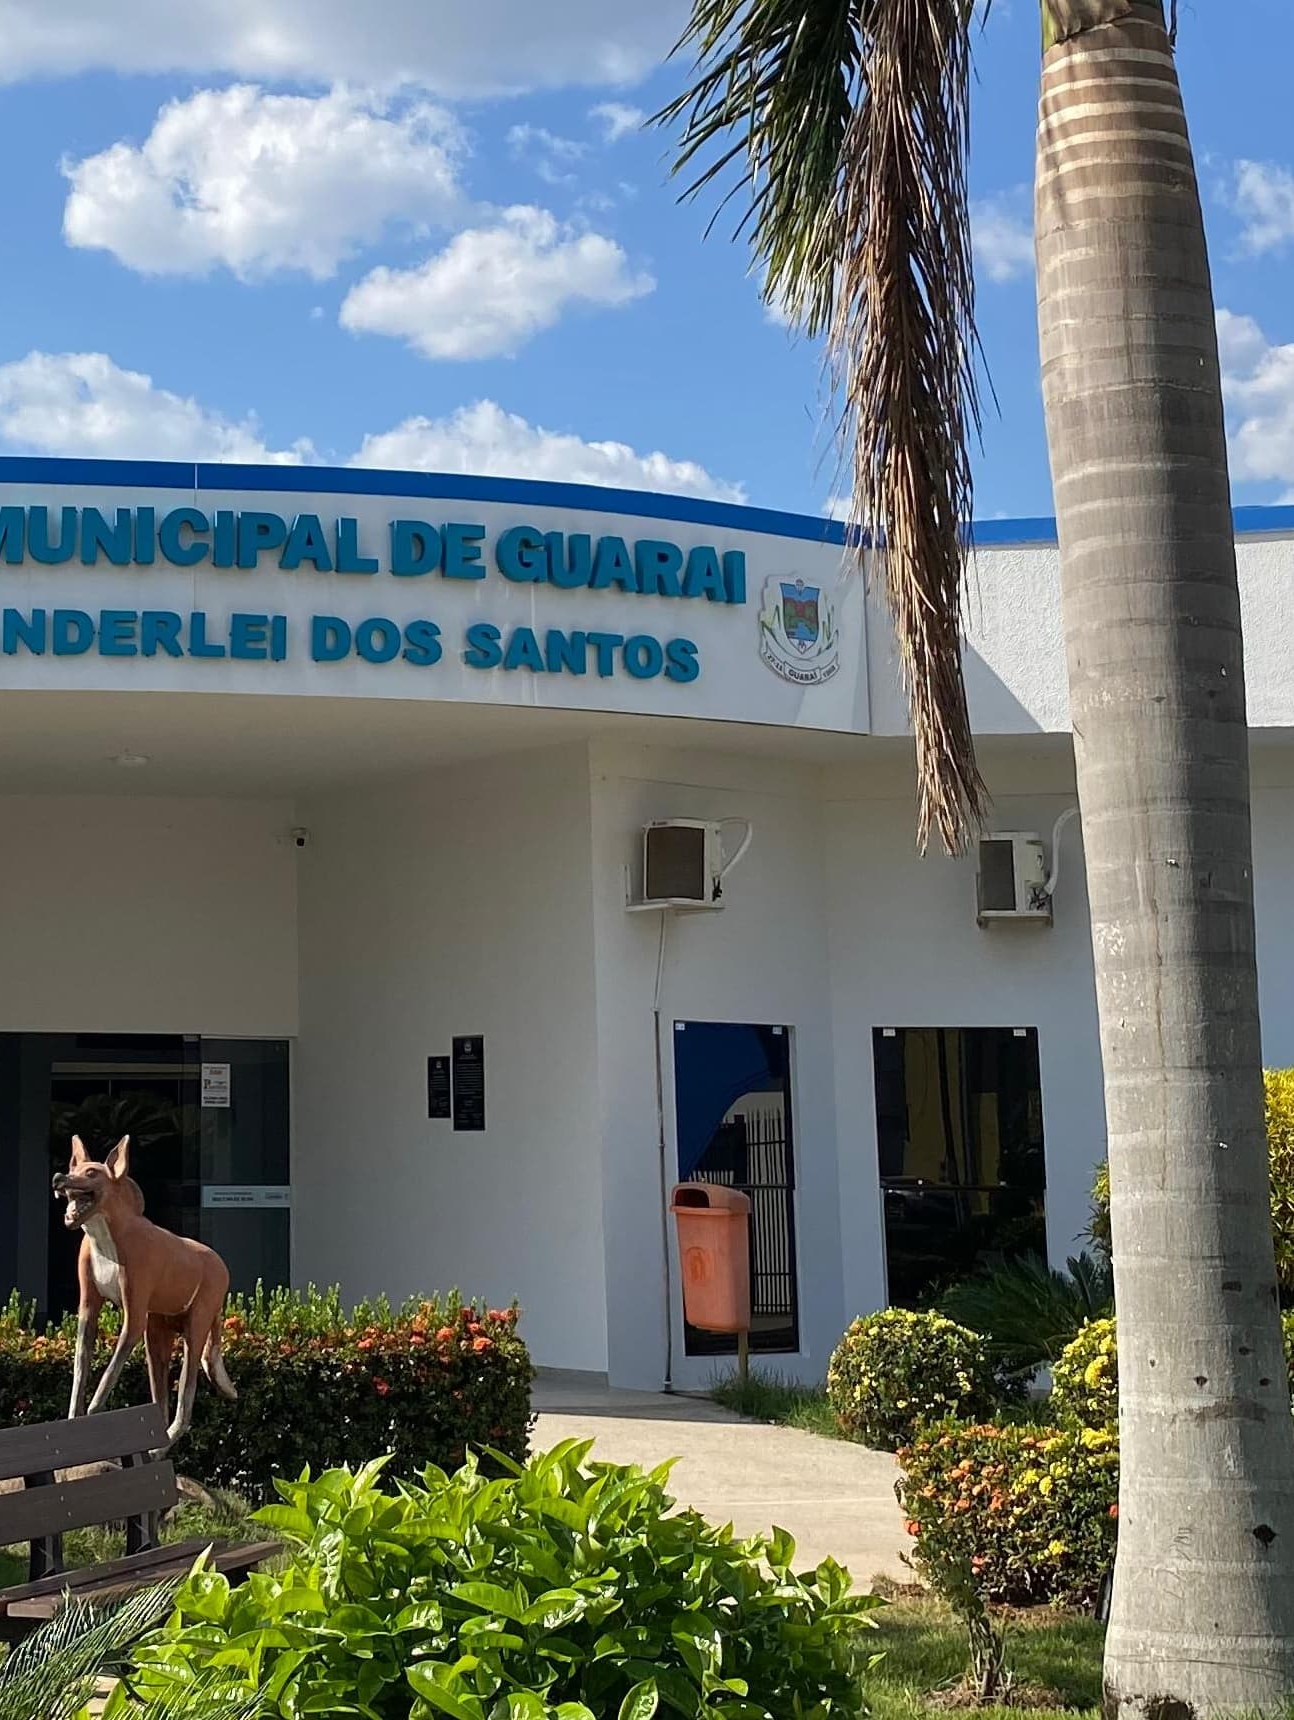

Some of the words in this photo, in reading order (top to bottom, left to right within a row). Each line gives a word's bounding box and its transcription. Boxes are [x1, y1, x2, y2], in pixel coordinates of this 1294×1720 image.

[390, 519, 487, 579] DE
[494, 525, 748, 605] GUARAI
[310, 615, 444, 666] DOS
[462, 623, 702, 684] SANTOS
